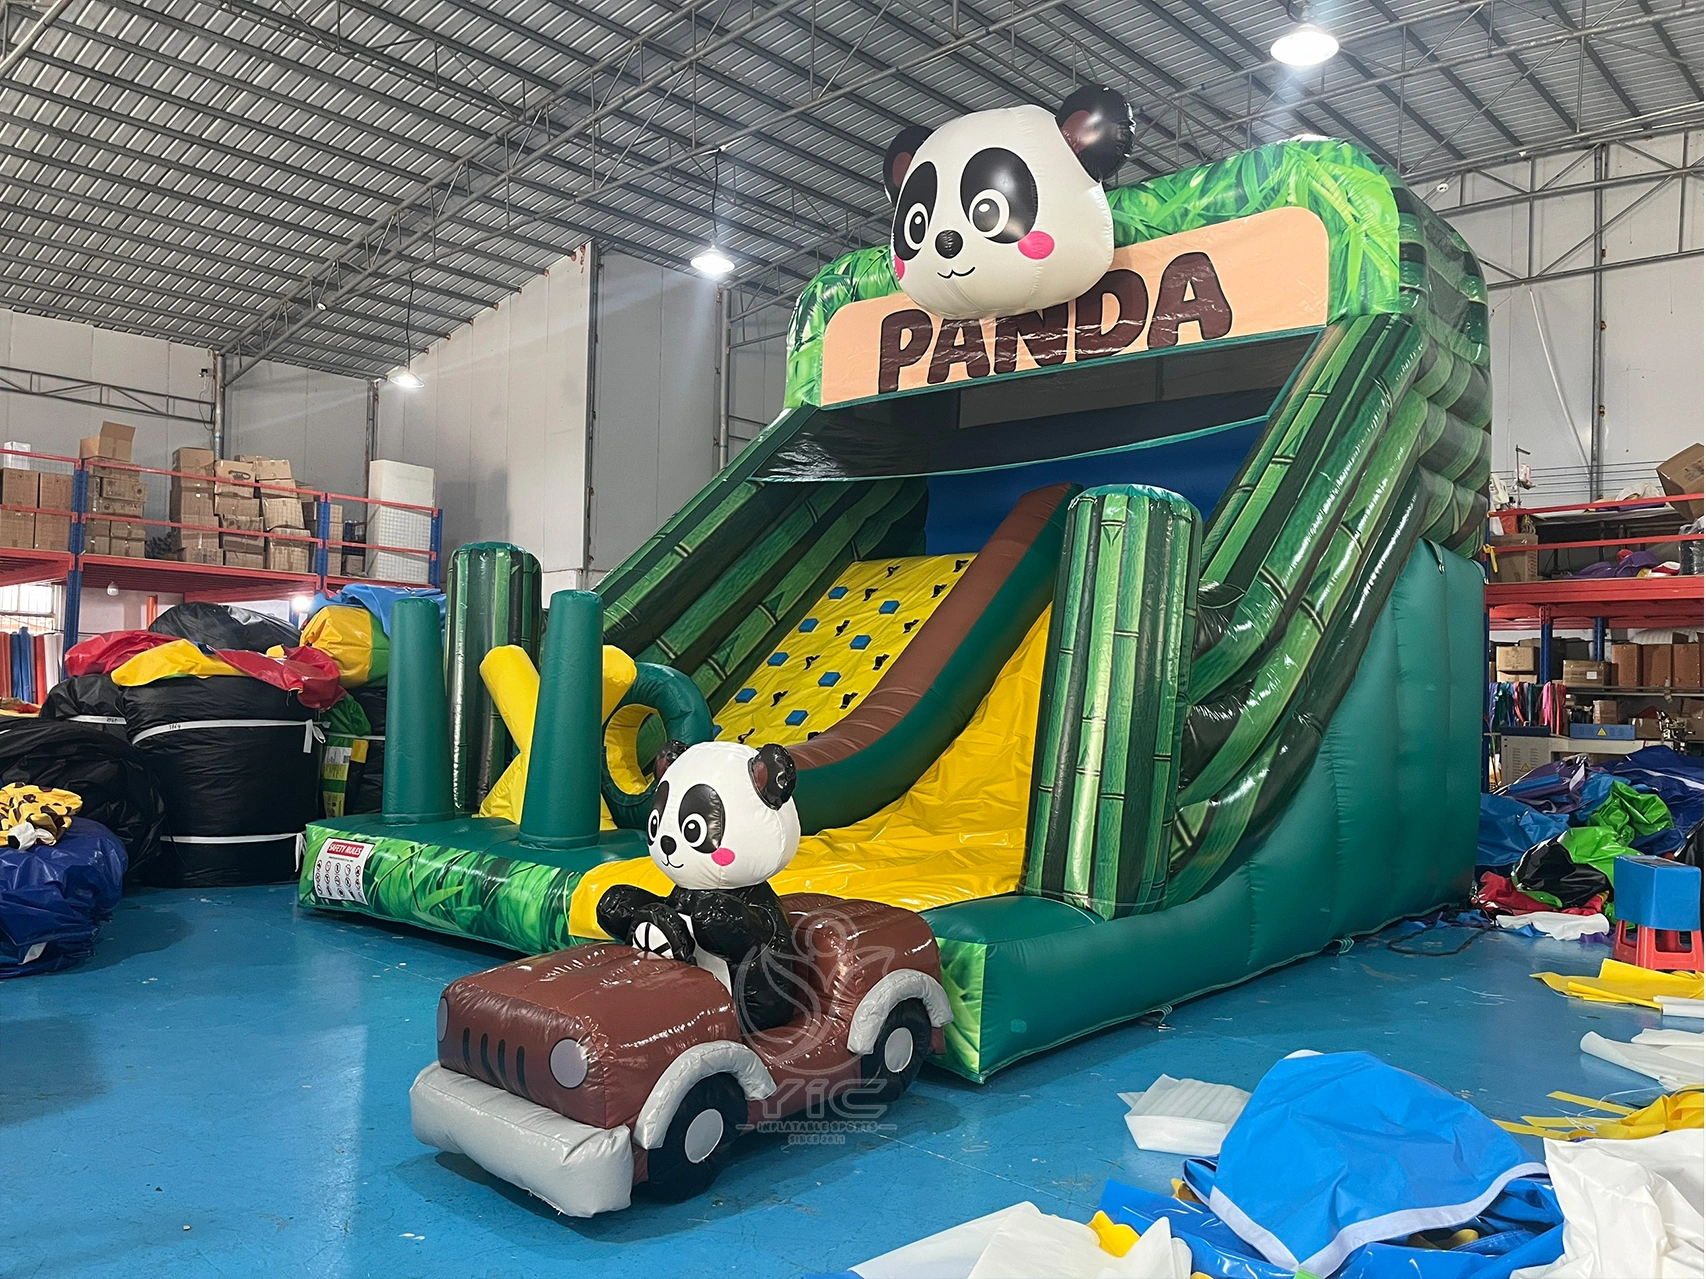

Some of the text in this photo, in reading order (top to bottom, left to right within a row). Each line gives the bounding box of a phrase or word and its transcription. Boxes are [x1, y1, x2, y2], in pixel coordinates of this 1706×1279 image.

[878, 251, 1233, 394] PANDA
[328, 843, 363, 855] SAFETY RULES
